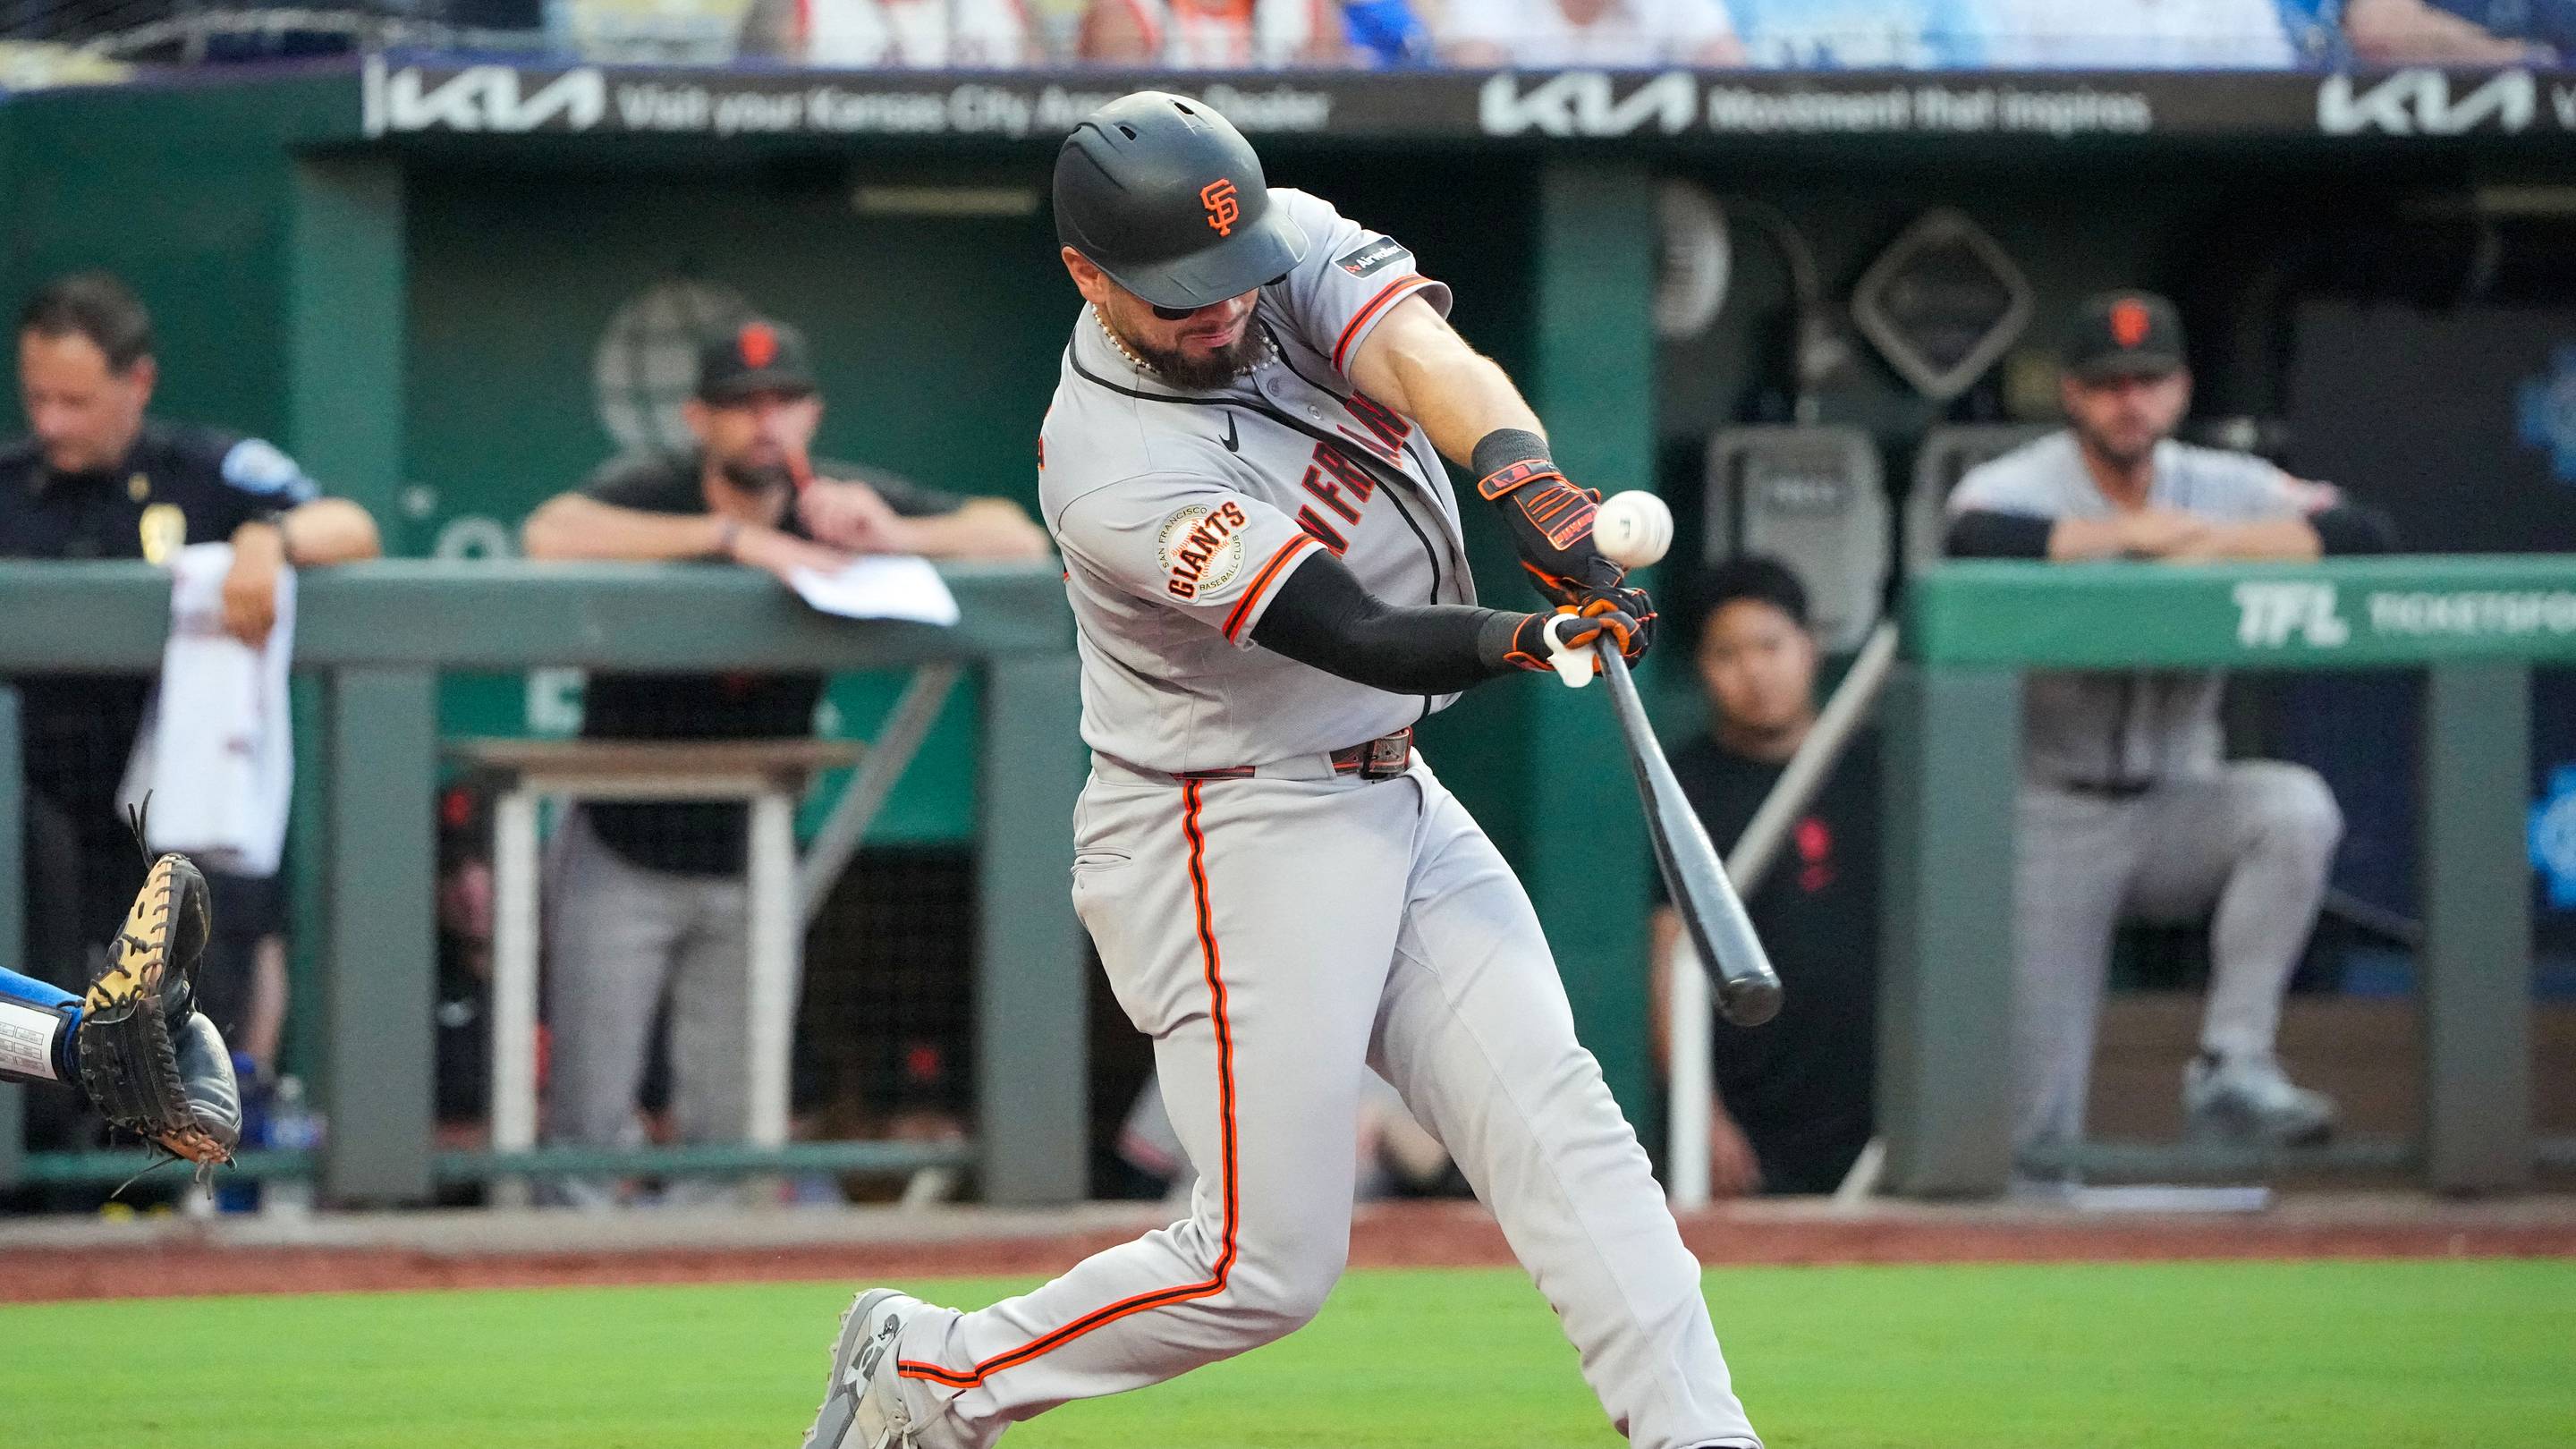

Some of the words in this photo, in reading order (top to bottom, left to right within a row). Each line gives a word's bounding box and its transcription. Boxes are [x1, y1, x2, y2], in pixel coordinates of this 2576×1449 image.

[1200, 178, 1239, 237] SF
[1158, 506, 1208, 544] FRANCISCO
[1167, 501, 1245, 598] GIANTS
[1158, 547, 1170, 569] SAN
[1199, 563, 1239, 591] BASEBALL
[1232, 534, 1241, 560] CLUB
